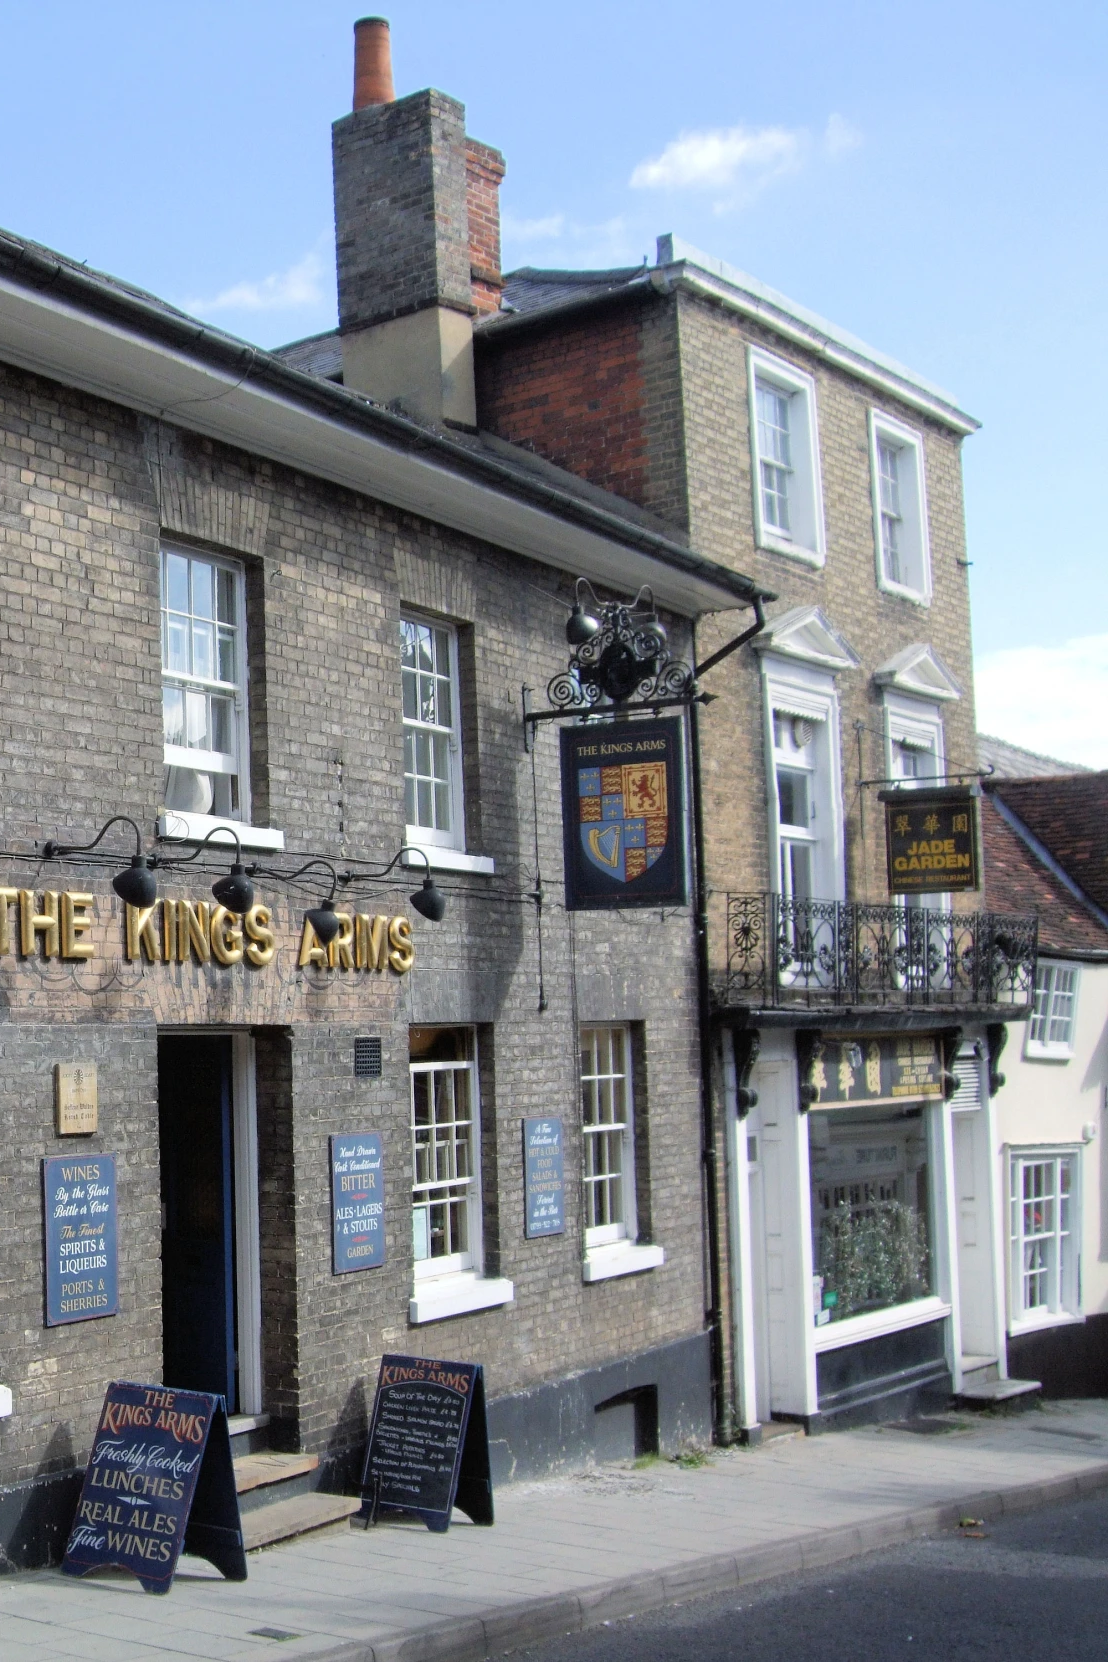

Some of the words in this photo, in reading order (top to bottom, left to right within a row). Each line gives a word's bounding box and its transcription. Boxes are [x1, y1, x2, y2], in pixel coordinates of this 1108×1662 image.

[577, 746, 597, 756] THE
[601, 742, 633, 754] KINGS
[636, 740, 666, 751] ARMS
[907, 839, 955, 855] JADE
[894, 854, 969, 871] GARDEN
[926, 874, 970, 882] RESTAURANT
[127, 898, 276, 966] KINGS
[299, 911, 414, 973] ARMS
[340, 1146, 355, 1157] Hand
[357, 1145, 376, 1156] Drawn
[529, 1148, 539, 1157] HOT
[545, 1146, 559, 1155] COLD
[334, 1161, 348, 1174] Cask
[350, 1158, 380, 1171] Conditioned
[538, 1160, 552, 1168] FOOD
[61, 1165, 100, 1182] WINES
[533, 1171, 552, 1181] SALADS
[553, 1170, 557, 1178] &
[341, 1173, 375, 1192] BITTER
[529, 1181, 561, 1193] SANDWICHES
[55, 1187, 68, 1204] By
[72, 1186, 85, 1199] the
[87, 1184, 109, 1200] Glass
[54, 1204, 78, 1218] Bottle
[80, 1206, 87, 1215] or
[61, 1226, 75, 1240] The
[79, 1222, 105, 1237] Finest
[343, 1224, 348, 1234] &
[351, 1219, 377, 1233] STOUTS
[60, 1239, 96, 1257] SPIRITS
[99, 1238, 105, 1251] &
[347, 1245, 373, 1258] GARDEN
[60, 1255, 107, 1274] LIQUEURS
[62, 1280, 93, 1297] PORTS
[98, 1279, 105, 1290] &
[61, 1294, 108, 1313] SHERRIES
[414, 1359, 442, 1370] THE
[381, 1365, 425, 1386] KINGS
[428, 1371, 470, 1394] ARMS
[144, 1391, 175, 1408] THE
[101, 1402, 152, 1434] KINGS
[155, 1410, 206, 1445] ARMS
[92, 1440, 146, 1473] Freshly
[145, 1446, 200, 1480] Cooked
[91, 1467, 185, 1501] LUNCHES
[80, 1500, 124, 1525] REAL
[128, 1507, 178, 1535] ALES
[67, 1525, 105, 1553] Fine
[107, 1530, 172, 1562] WINES
